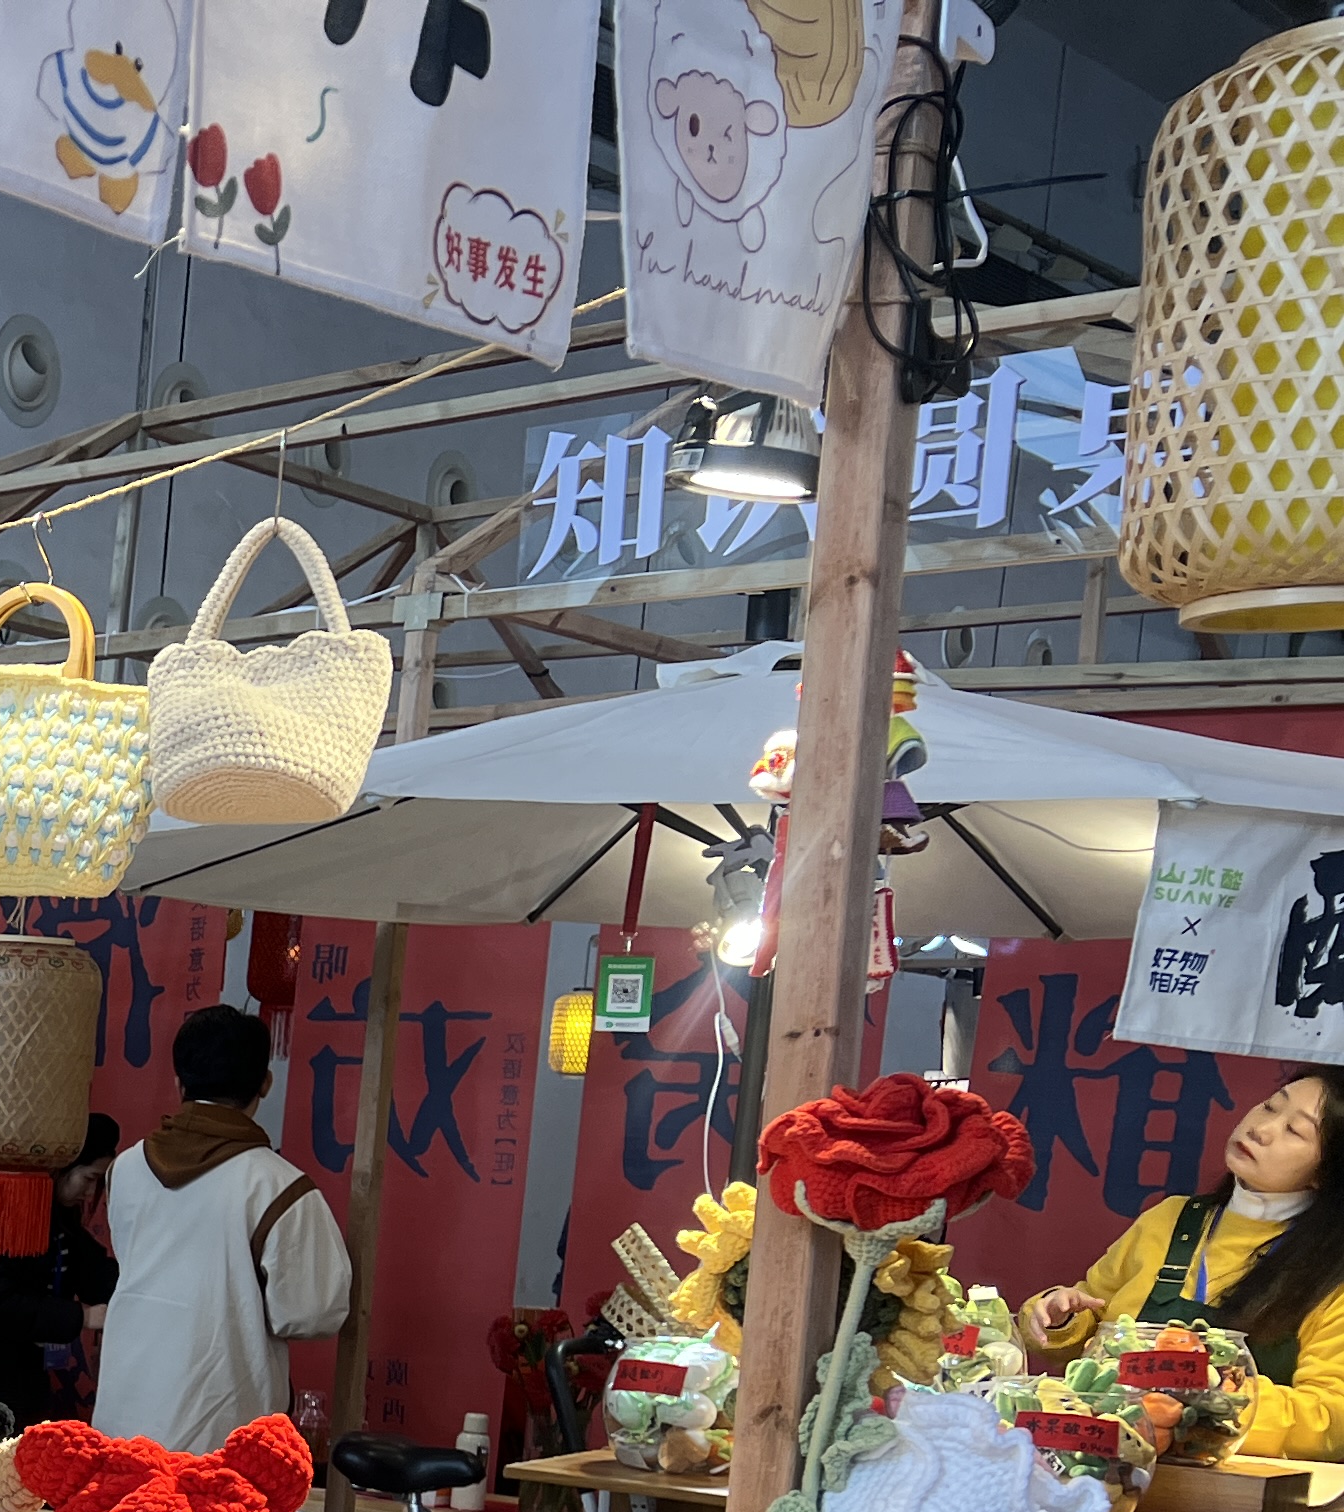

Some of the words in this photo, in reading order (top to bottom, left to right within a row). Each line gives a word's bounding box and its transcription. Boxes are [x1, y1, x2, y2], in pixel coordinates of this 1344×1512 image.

[444, 224, 547, 299] 好事发生
[635, 229, 676, 274] Yu
[683, 238, 828, 317] handmade
[1149, 970, 1200, 996] 相承
[1151, 947, 1210, 974] 好物
